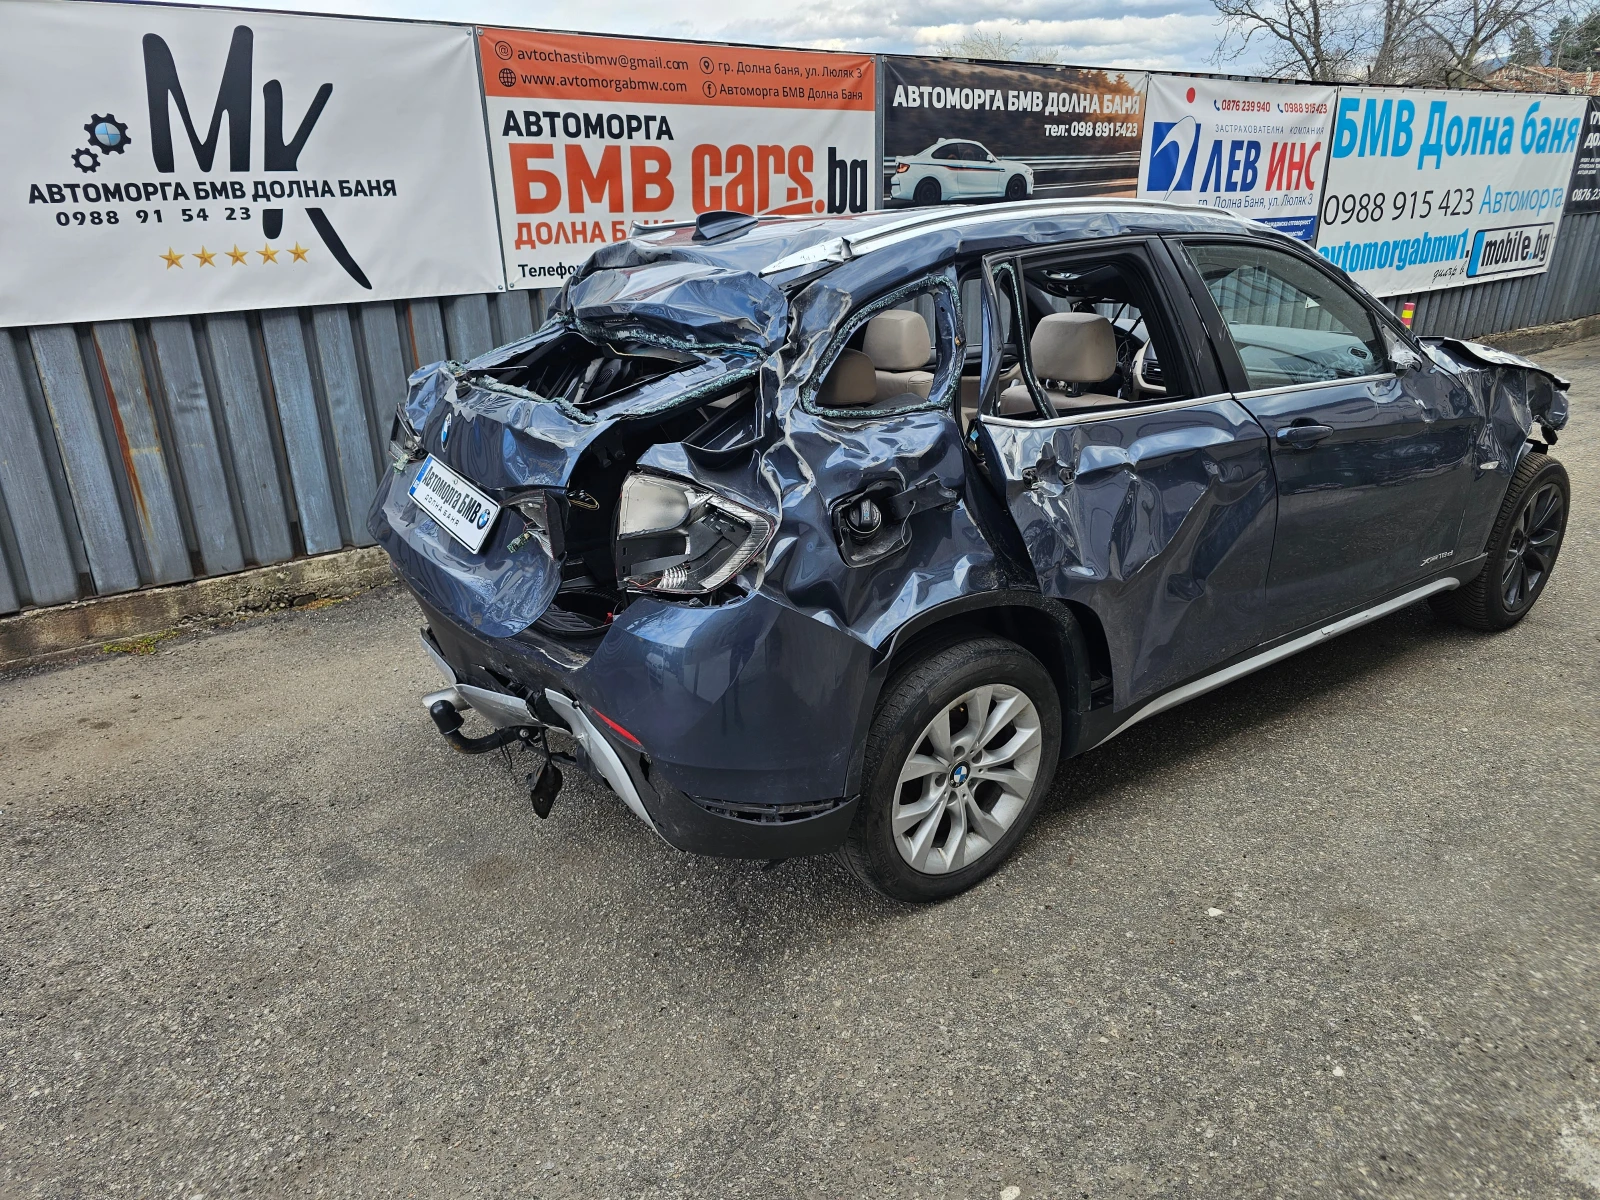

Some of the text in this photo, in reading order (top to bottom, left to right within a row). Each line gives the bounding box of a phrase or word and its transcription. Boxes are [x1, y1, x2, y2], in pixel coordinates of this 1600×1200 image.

[517, 49, 689, 70] avtochastibmw@gmail.com
[718, 61, 863, 79] гр. Долна баня, ул. Люляк 3
[520, 73, 687, 92] www.avtomorgabmw.com
[719, 83, 863, 101] Автоморга БМВ Долна Баня
[892, 84, 1140, 117] АВТОМОРГА БМВ ДОЛНА БАНЯ
[1221, 99, 1271, 113] 0876 239 940
[1284, 102, 1303, 113] 0988
[503, 109, 674, 141] АВТОМОРГА
[1044, 124, 1069, 136] тел:
[1070, 121, 1093, 137] 098
[1215, 124, 1325, 135] ЗАСТРАХОВАТЕЛНА КОМПАНИЯ
[1332, 97, 1581, 170] БМВ Долна баня
[508, 143, 674, 214] БМВ
[1199, 140, 1322, 193] ЛЕВ ИНС
[29, 179, 397, 205] АВТОМОРГА БМВ ДОЛНА БАНЯ
[1281, 194, 1307, 207] Люляк
[1479, 184, 1564, 216] Автоморга
[55, 207, 251, 226] 0988 91 54 23
[1323, 187, 1475, 225] 0988 915 423
[514, 221, 606, 250] ДОЛНА
[1480, 229, 1550, 268] mobile.bg
[422, 466, 482, 524] Автоморга БМВ
